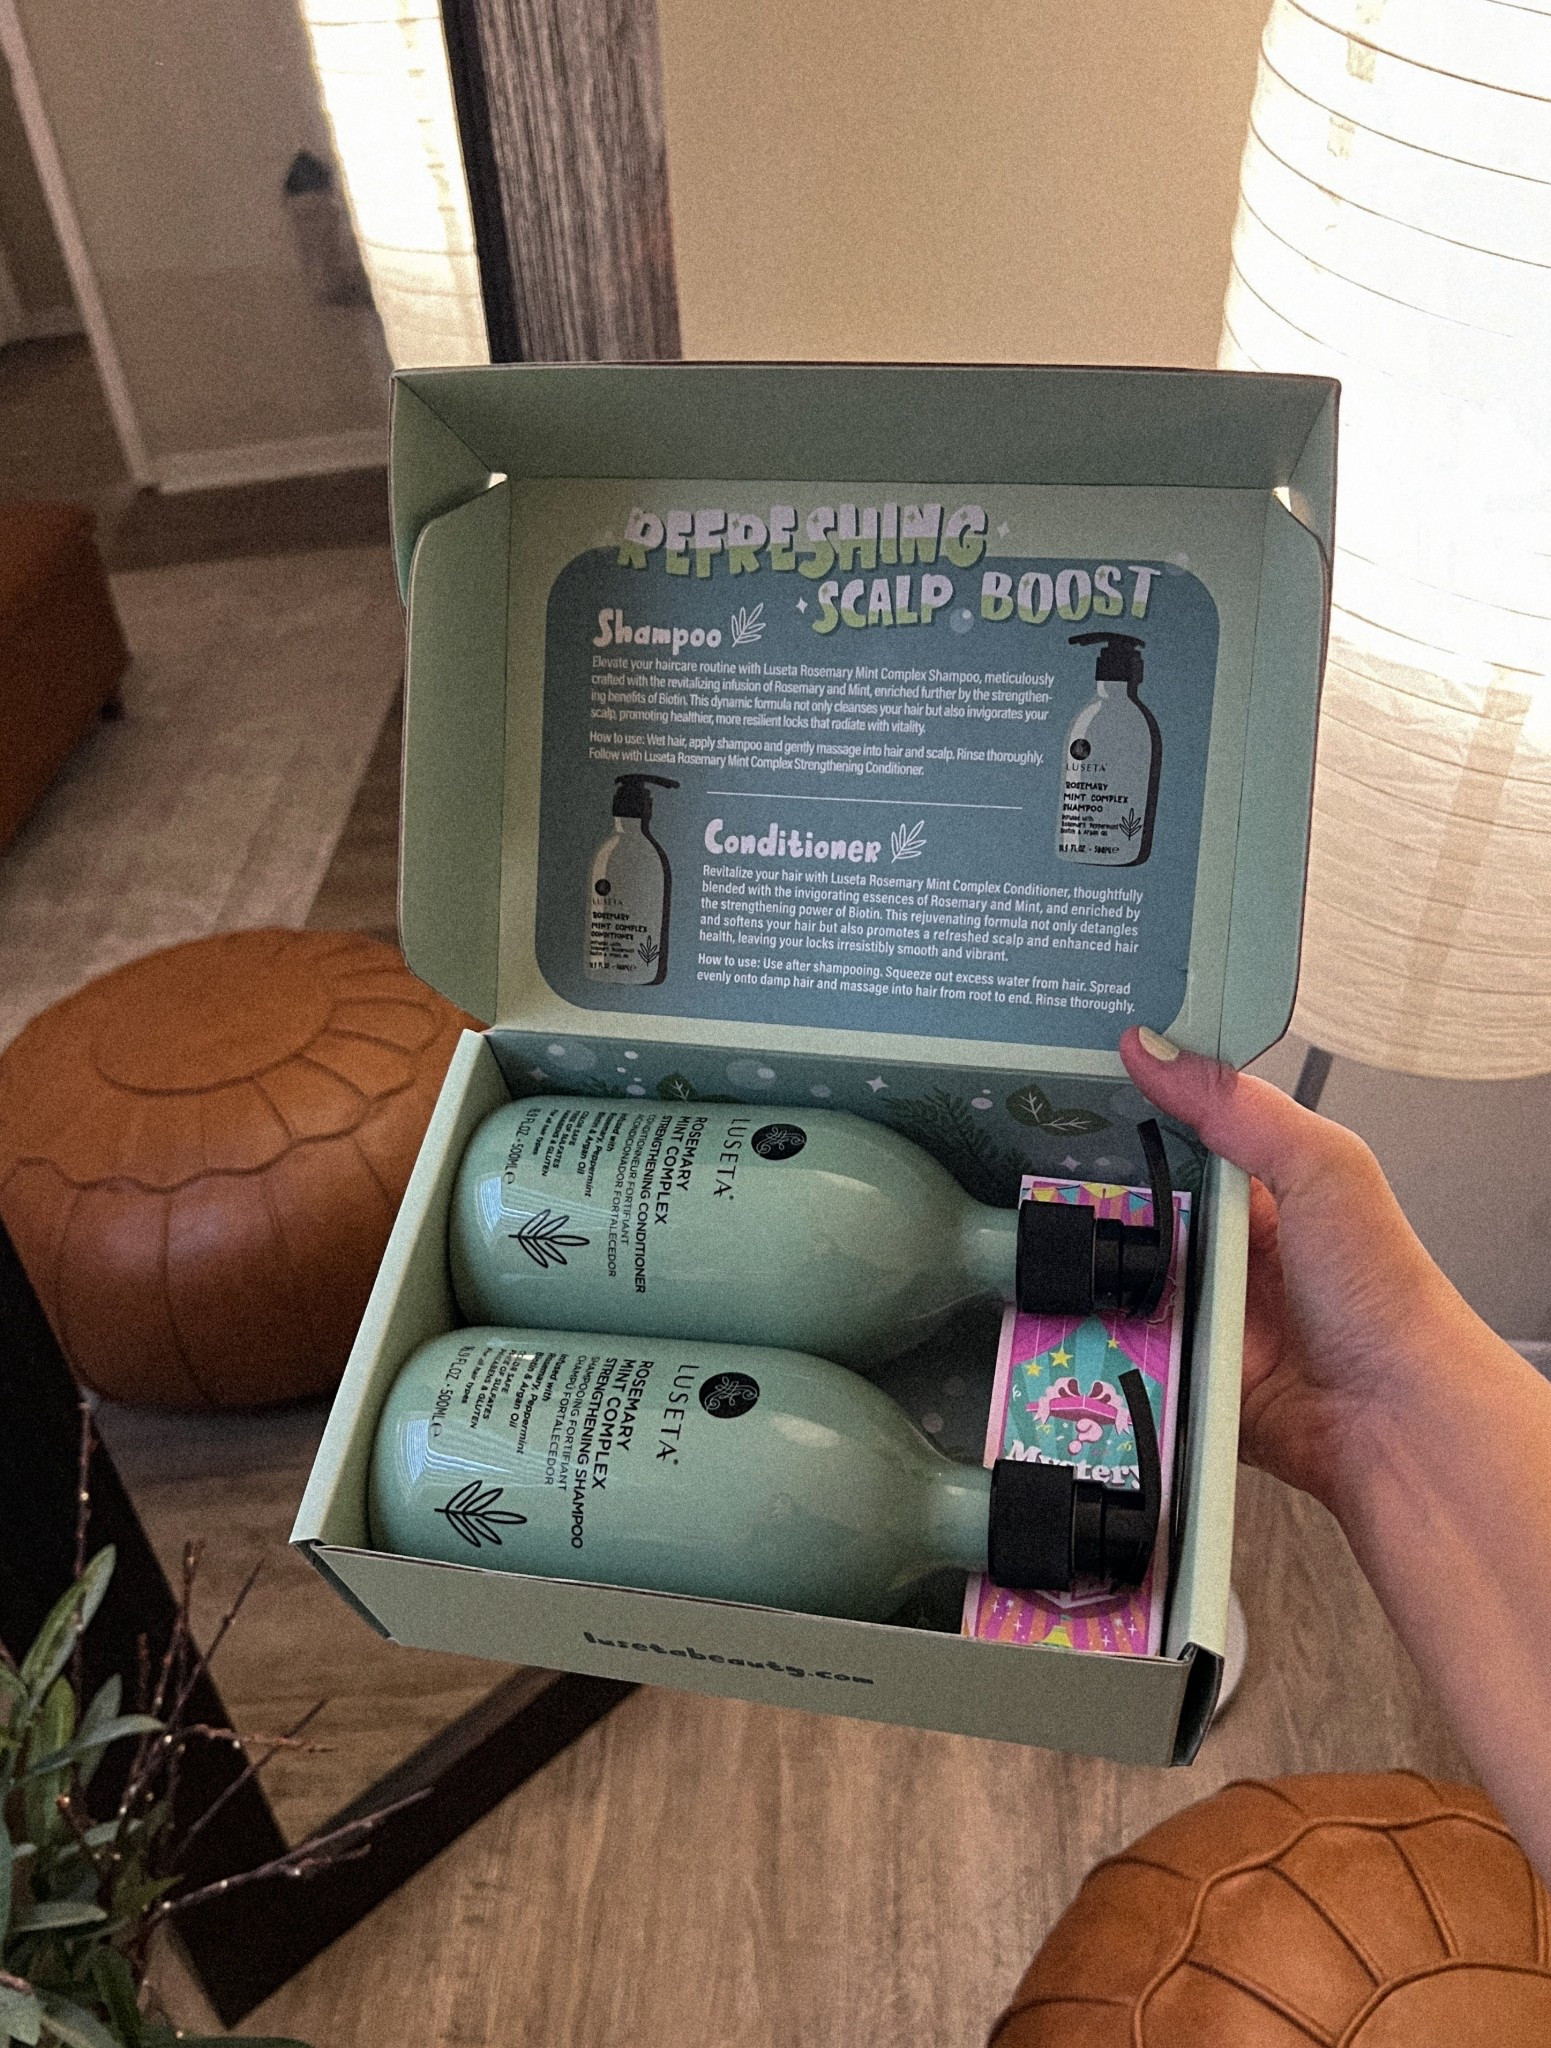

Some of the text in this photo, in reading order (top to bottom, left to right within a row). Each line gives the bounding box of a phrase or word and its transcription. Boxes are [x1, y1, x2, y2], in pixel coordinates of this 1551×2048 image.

[617, 502, 989, 580] REFRESHING
[812, 565, 1162, 635] SCALP BOOST
[593, 607, 722, 655] Shampoo
[591, 672, 1053, 706] crafted with the revitalizing infusion of Rosemary and Mint, enriched further by the strengthen-
[592, 655, 1055, 688] Elevate your haircare routine with Luseta Rosemary Mint Complex Shampoo, meticulously
[1065, 781, 1108, 791] ROSEMARY
[1066, 763, 1107, 772] LUSETA
[1063, 792, 1129, 804] MINT COMPLEX
[1063, 803, 1103, 813] SHAMPOO
[704, 818, 881, 863] Conditioner
[702, 863, 1144, 904] Revitalize your hair with Luseta Rosemary Mint Complex Conditioner, thoughtfully
[702, 880, 1141, 922] blended with the invigorating essences of Rosemary and Mint, and enriched by
[700, 895, 1139, 939] the strengthening power of Biotin. This rejuvenating formula not only detangles
[700, 912, 1139, 952] and softens your hair but also promotes a refreshed scalp and enhanced hair
[699, 928, 1009, 960] health, leaving your locks irresistibly smooth and vibrant.
[698, 952, 1131, 998] How to use: Use after shampooing. Squeeze out excess water from hair. Spread
[541, 1146, 555, 1178] GLUTEN
[553, 1133, 570, 1169] SULFATES
[580, 1135, 594, 1160] Argan
[584, 1112, 617, 1197] Rosemary, Peppermint
[606, 1134, 618, 1152] with
[676, 1116, 708, 1191] ROSEMARY
[577, 1161, 587, 1175] Oil
[621, 1114, 656, 1245] CONDITIONNEUR FORTIFIANT
[654, 1115, 692, 1225] MINT COMPLEX
[608, 1114, 644, 1278] ACONDICIONADOR FORTALECEDOR
[634, 1115, 673, 1294] STRENGTHENING CONDITIONER
[513, 1381, 529, 1411] Argan
[541, 1353, 569, 1402] Infused with
[509, 1413, 520, 1429] Oil
[516, 1352, 556, 1455] Rosemary, Peppermint
[544, 1355, 587, 1485] CHAMPÚ FORTALECEDOR
[558, 1356, 600, 1492] SHAMPOOING FORTIFIANT
[592, 1359, 637, 1490] MINT COMPLEX
[617, 1360, 654, 1451] ROSEMARY
[571, 1357, 618, 1549] STRENGTHENING SHAMPOO
[583, 1631, 875, 1685] lusetabeauty.com
